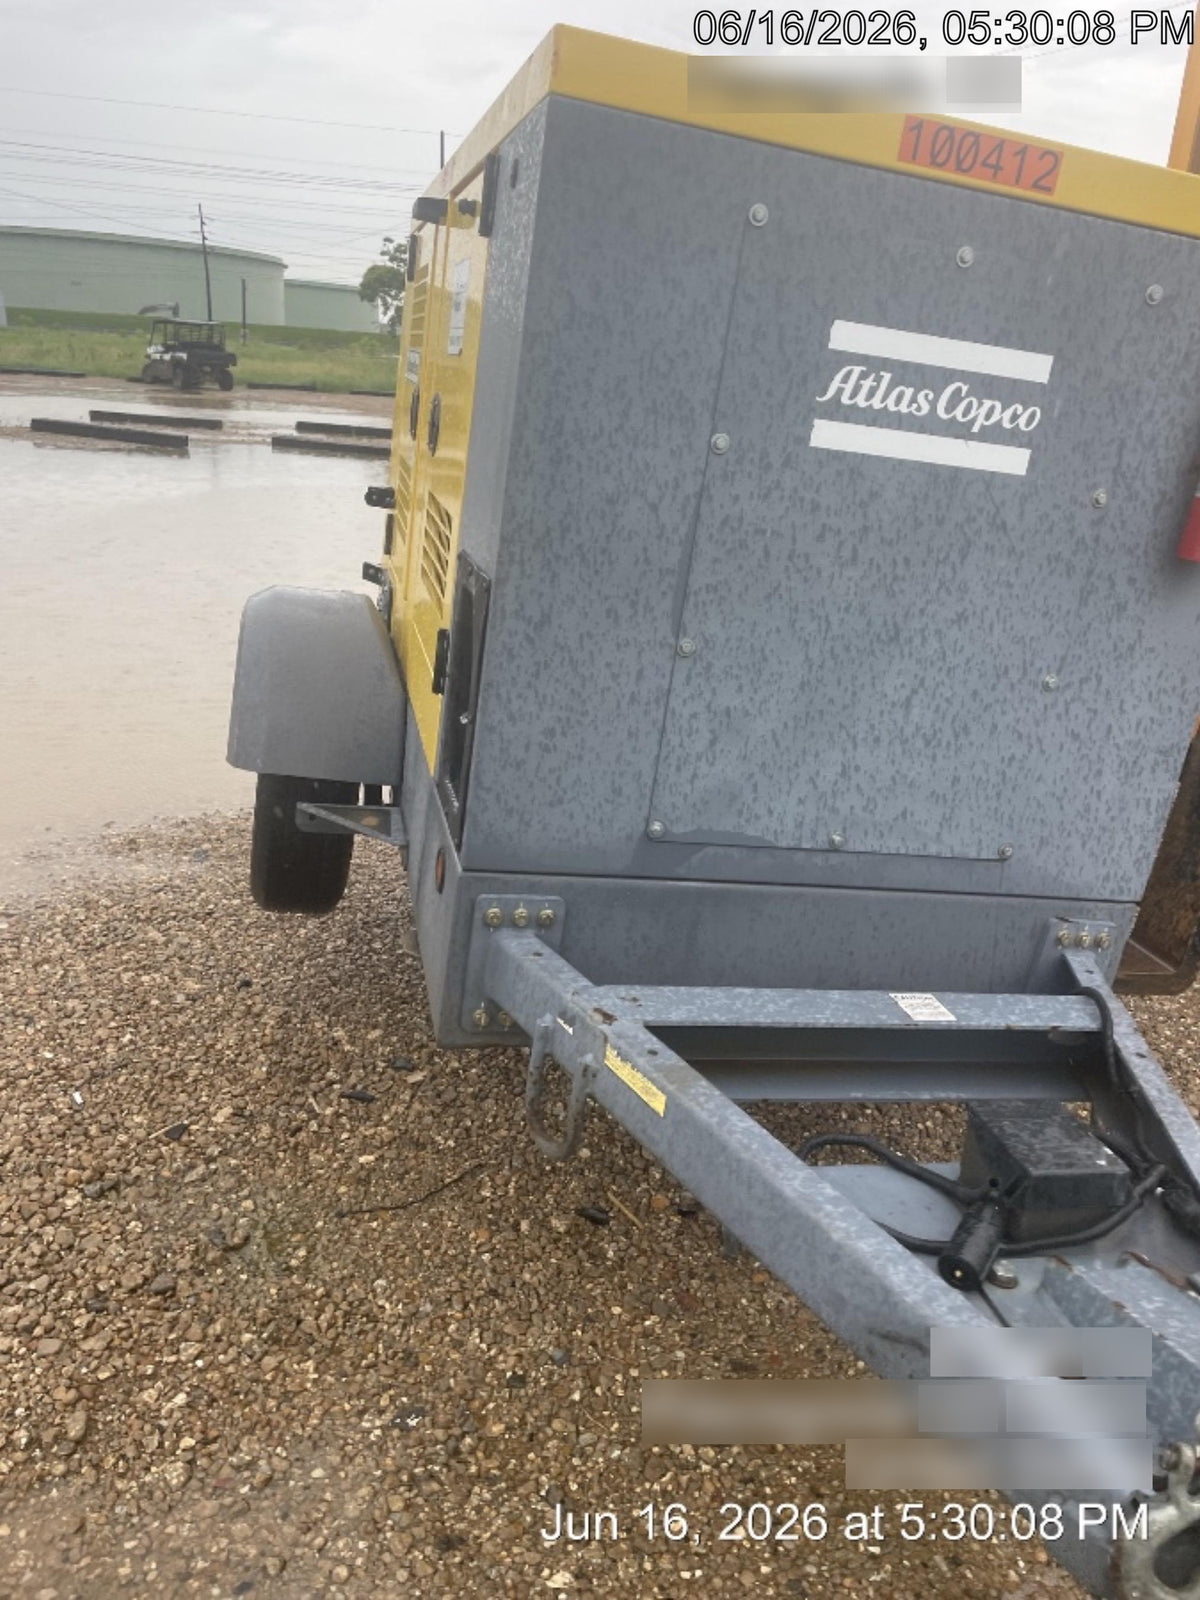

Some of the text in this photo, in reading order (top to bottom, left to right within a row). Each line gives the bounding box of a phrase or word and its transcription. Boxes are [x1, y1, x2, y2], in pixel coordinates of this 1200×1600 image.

[906, 121, 1059, 192] 100412
[817, 366, 1041, 432] Atlas Copco
